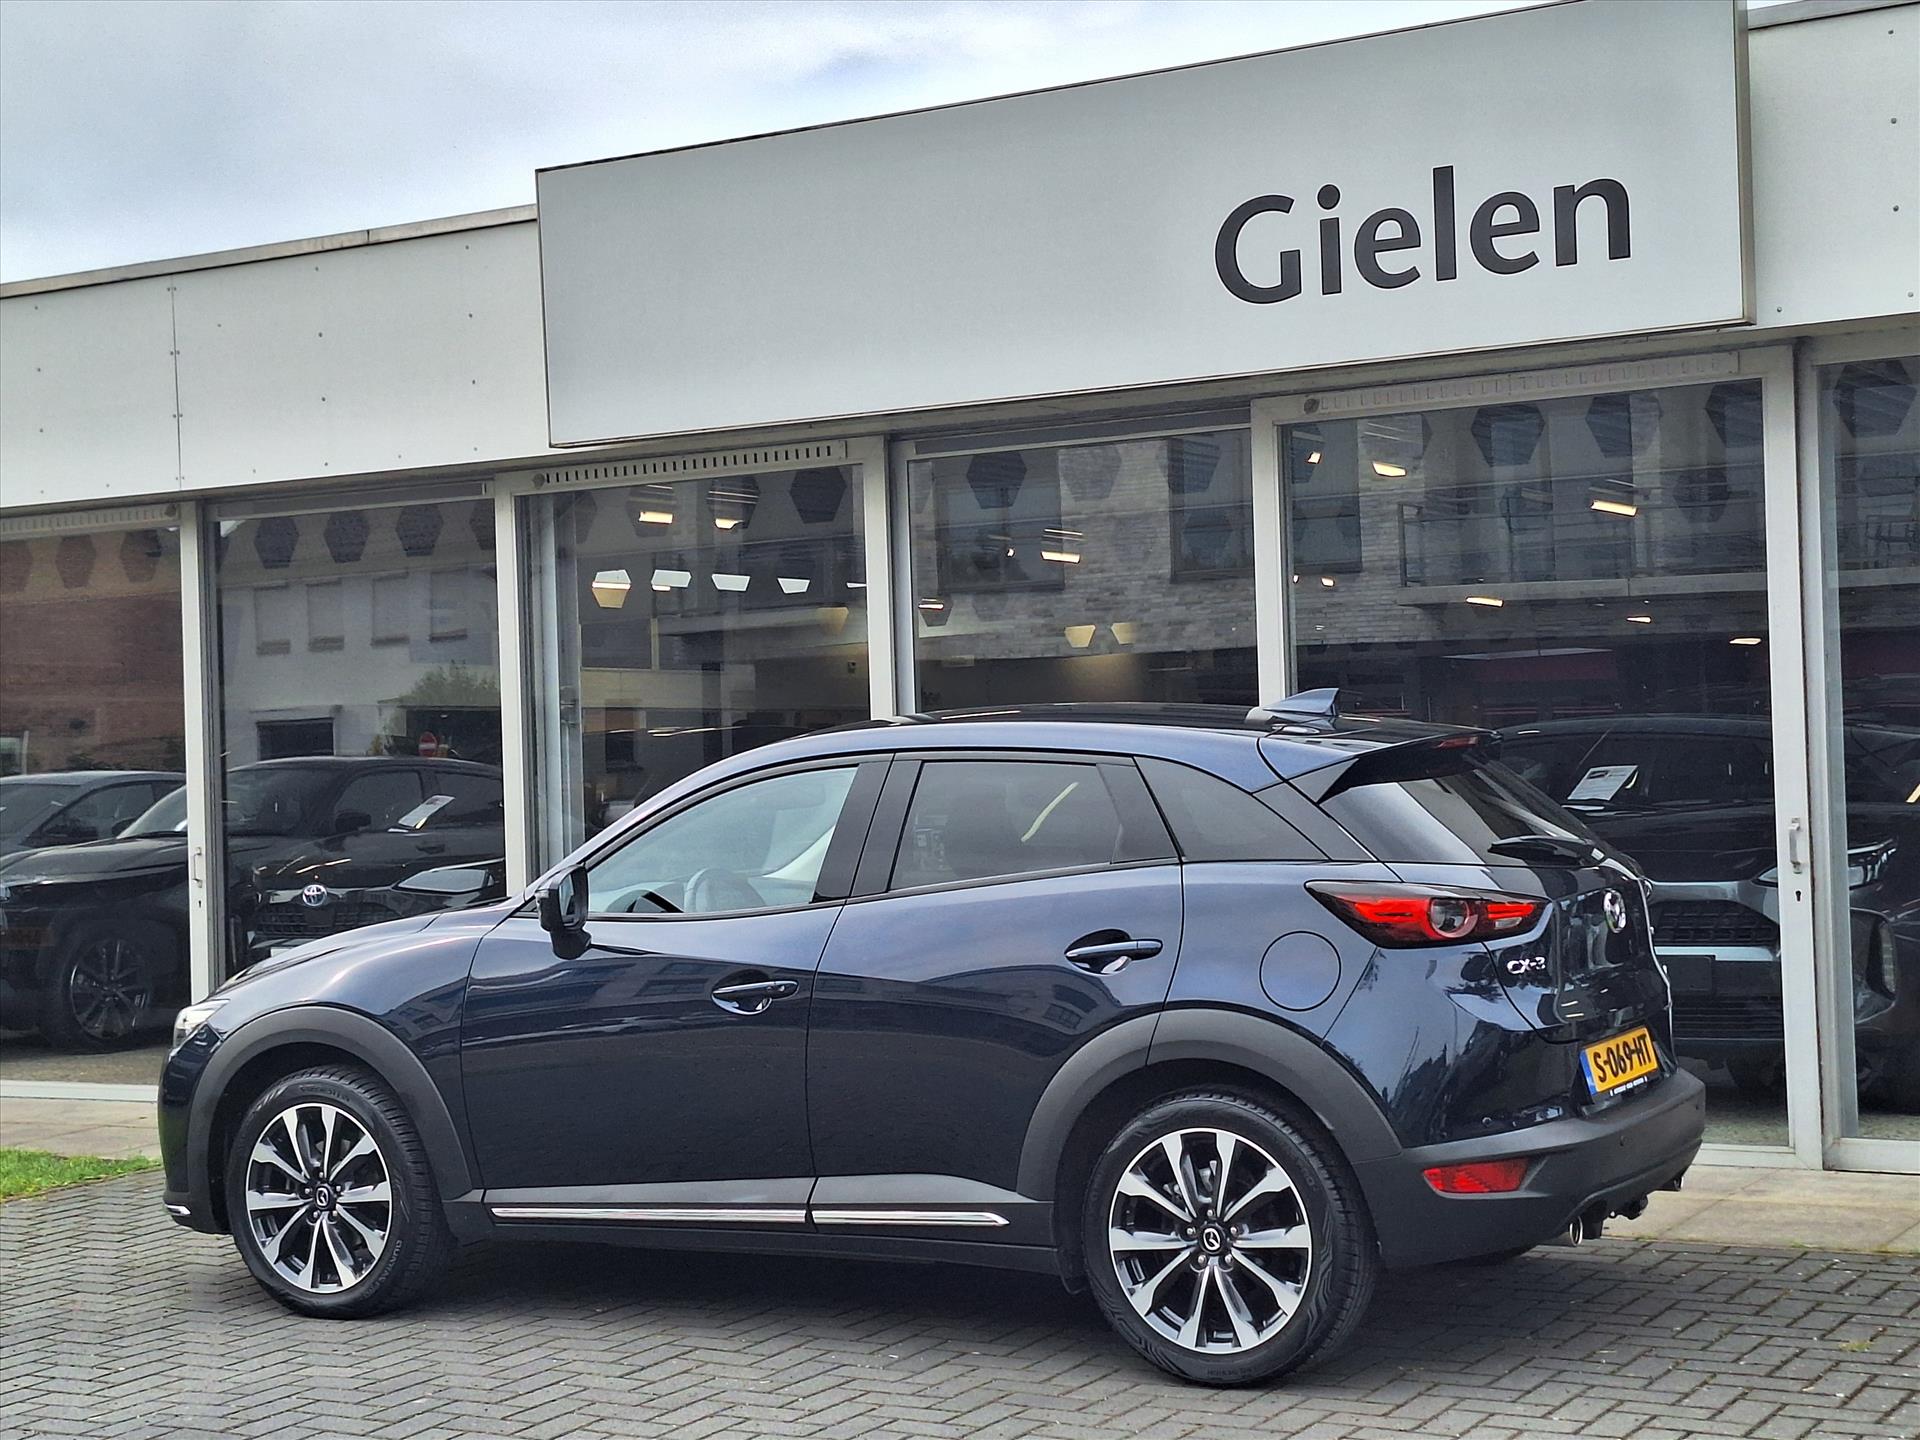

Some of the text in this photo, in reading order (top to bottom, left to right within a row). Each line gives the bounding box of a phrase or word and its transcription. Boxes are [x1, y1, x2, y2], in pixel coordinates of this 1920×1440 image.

[1214, 165, 1631, 304] Gielen
[1506, 956, 1546, 975] CX-3
[1593, 1033, 1652, 1083] S-069-HT
